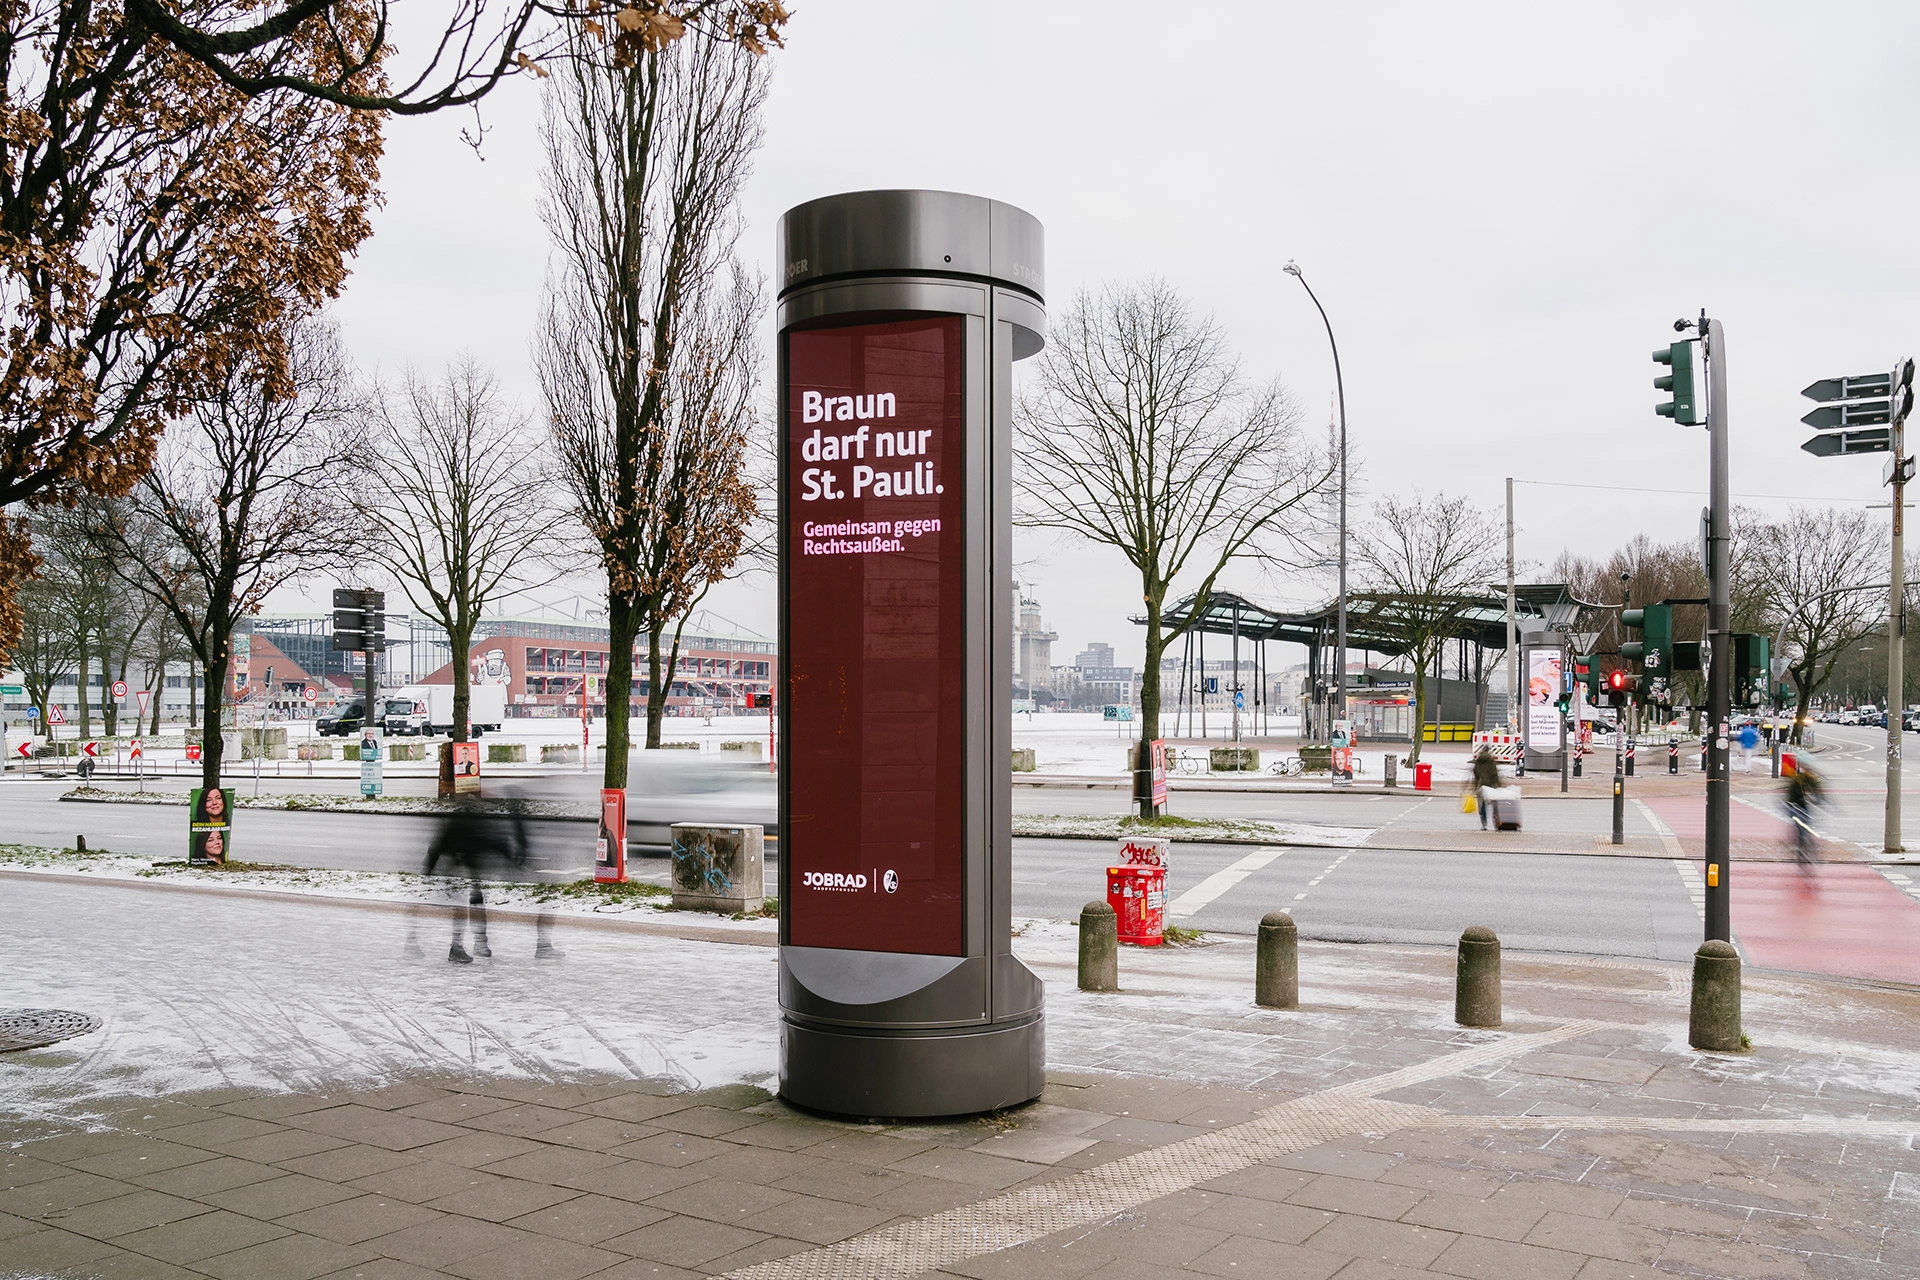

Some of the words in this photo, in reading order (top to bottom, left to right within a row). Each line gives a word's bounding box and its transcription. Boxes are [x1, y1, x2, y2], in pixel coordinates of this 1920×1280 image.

[785, 259, 808, 279] RÖER
[1013, 263, 1042, 287] STRÖE
[802, 390, 896, 424] Braun
[801, 425, 870, 462] darf
[875, 429, 932, 458] nur
[801, 468, 845, 501] St.
[853, 461, 944, 499] Pauli.
[803, 519, 891, 537] Gemeinsam
[894, 519, 941, 538] gegen
[803, 538, 905, 555] Rechtsaußen.
[115, 685, 125, 693] 30
[307, 690, 315, 698] 30
[606, 796, 618, 804] SPD
[802, 872, 867, 889] JOBRAD
